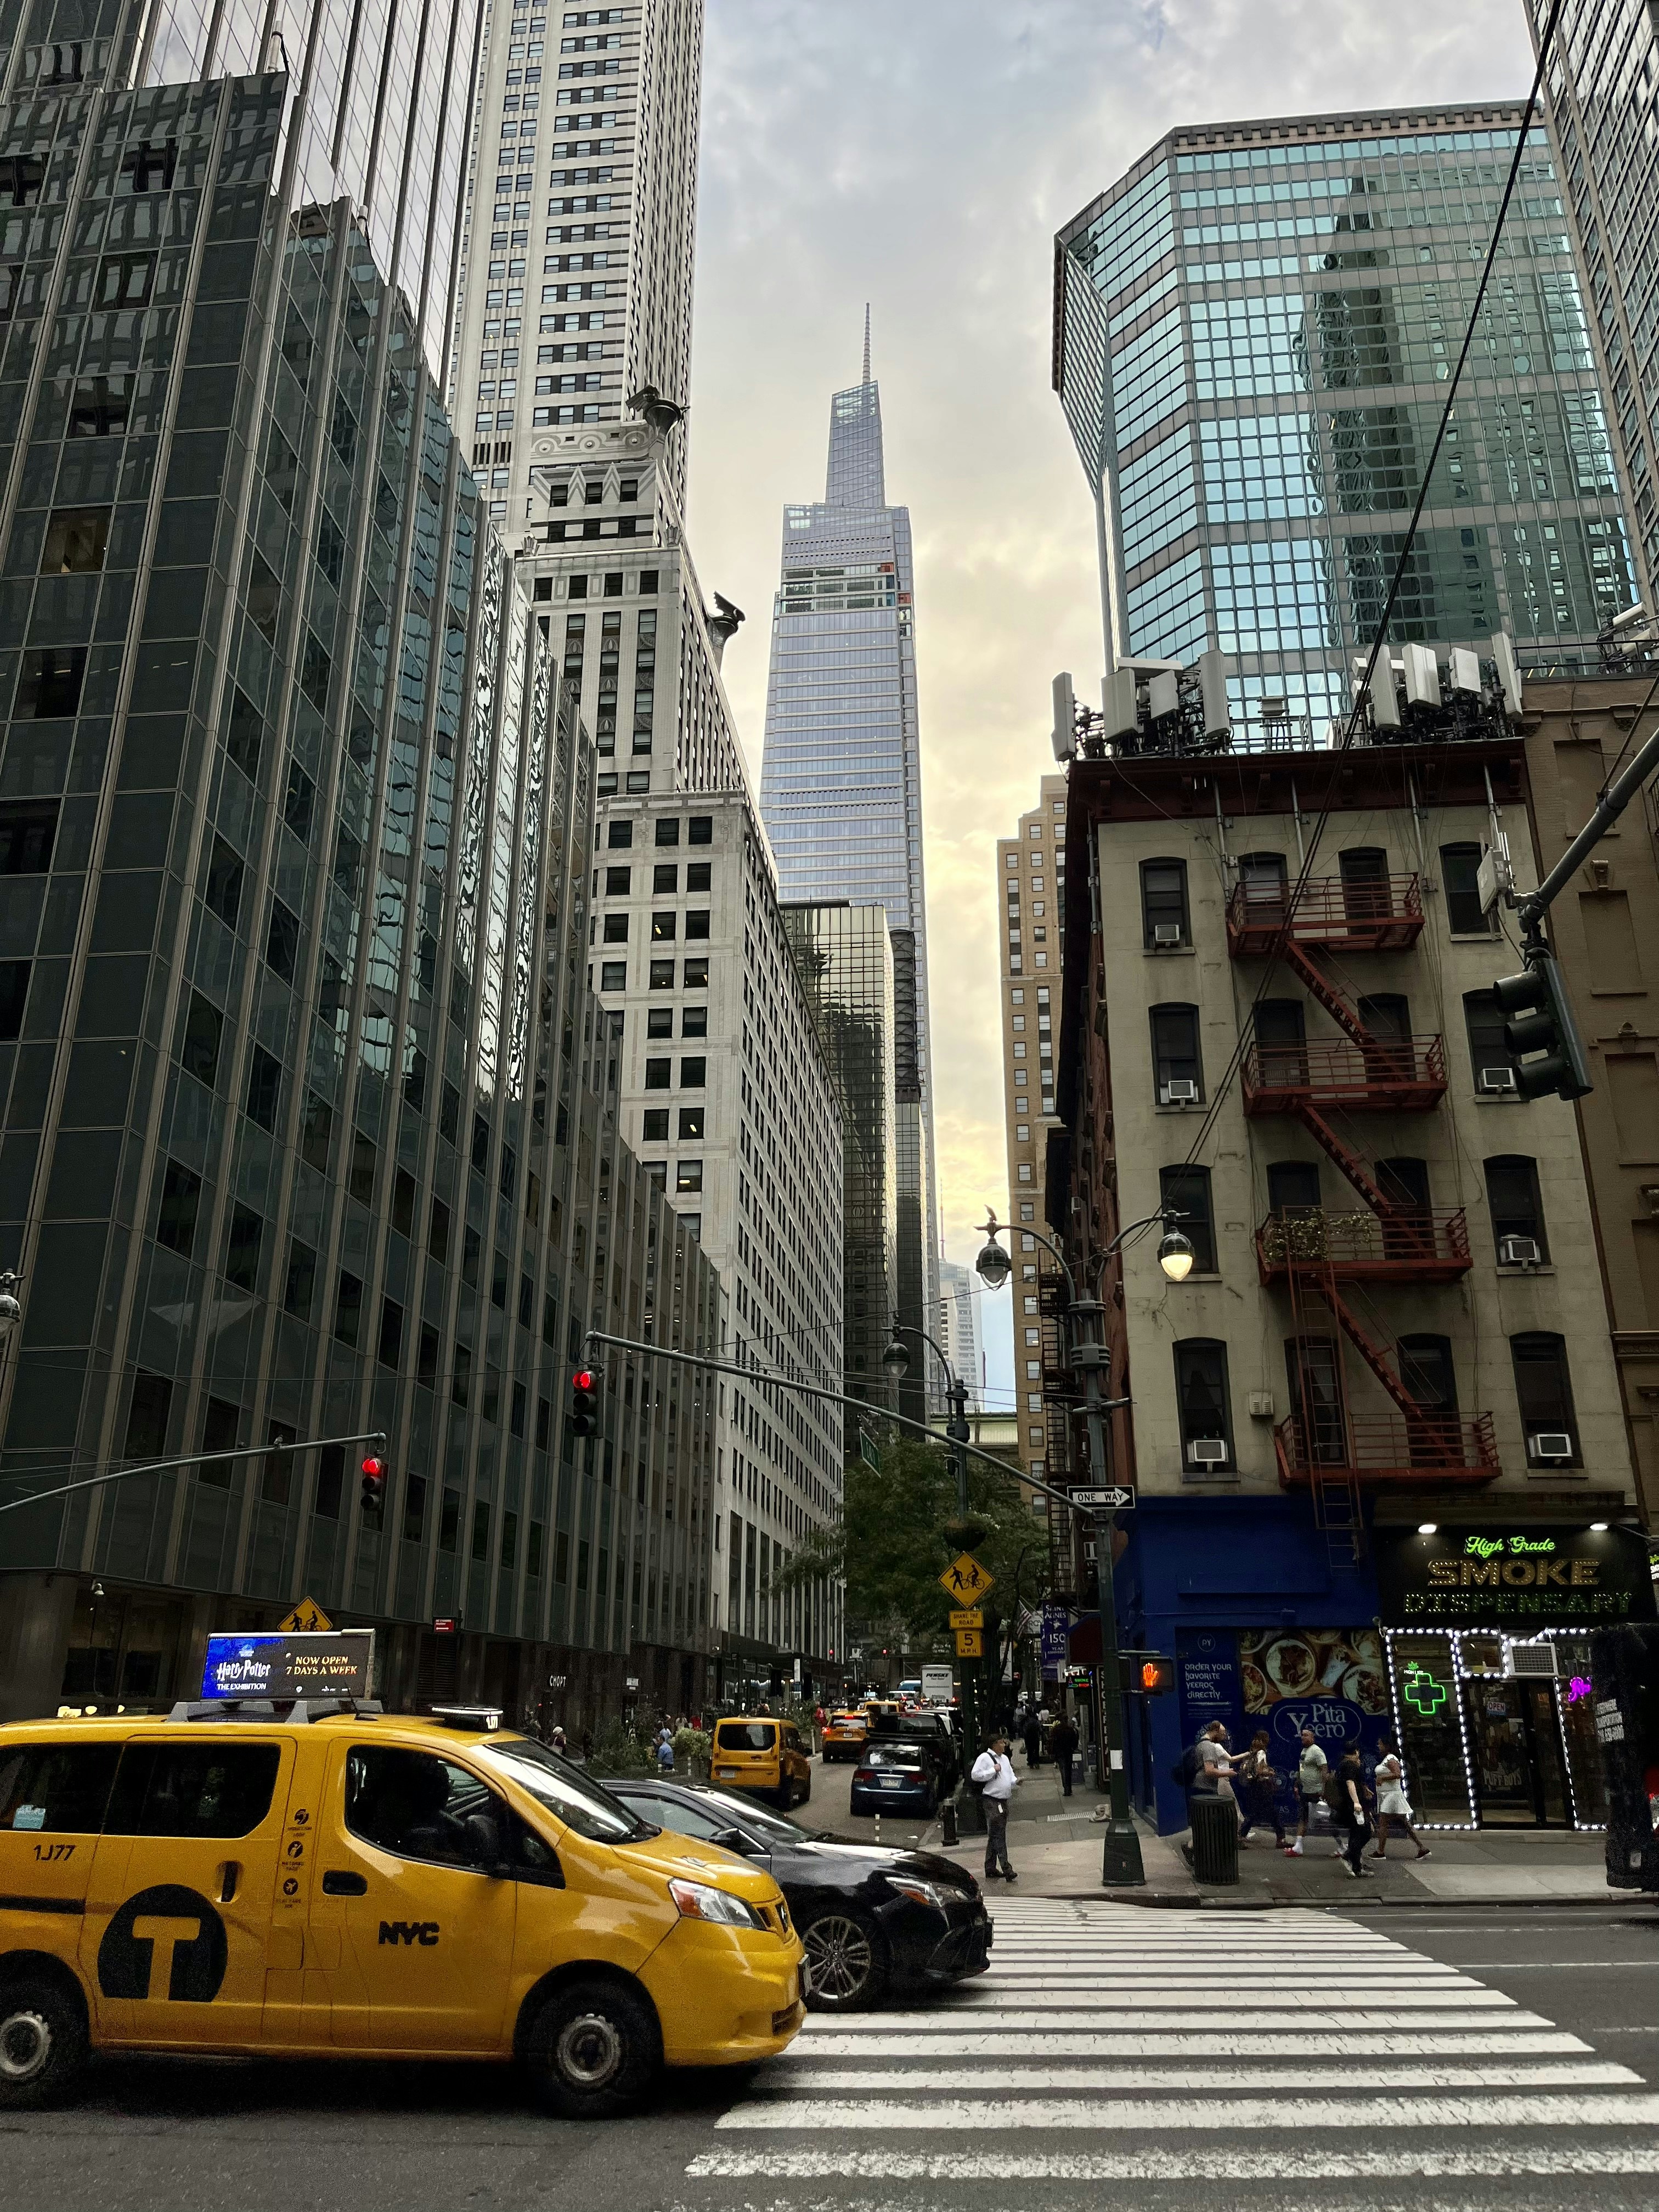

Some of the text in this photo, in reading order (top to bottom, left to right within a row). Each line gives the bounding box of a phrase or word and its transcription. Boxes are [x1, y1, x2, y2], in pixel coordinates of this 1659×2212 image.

[1104, 1492, 1124, 1501] WAY
[1464, 1536, 1555, 1558] High Grade
[1427, 1559, 1600, 1585] SMOKE
[1404, 1592, 1633, 1613] DISPENSARY
[964, 1633, 973, 1646] 5
[296, 1656, 348, 1664] NOW OPEN
[217, 1660, 271, 1681] Harry Potter
[286, 1666, 358, 1675] 7 DAYS A WEEK
[550, 1675, 566, 1688] CHOPT
[1311, 1703, 1347, 1723] Pita
[1488, 1702, 1505, 1711] OPEN
[33, 1844, 76, 1861] 1J77
[378, 1921, 439, 1946] NYC
[132, 1915, 201, 2000] T
